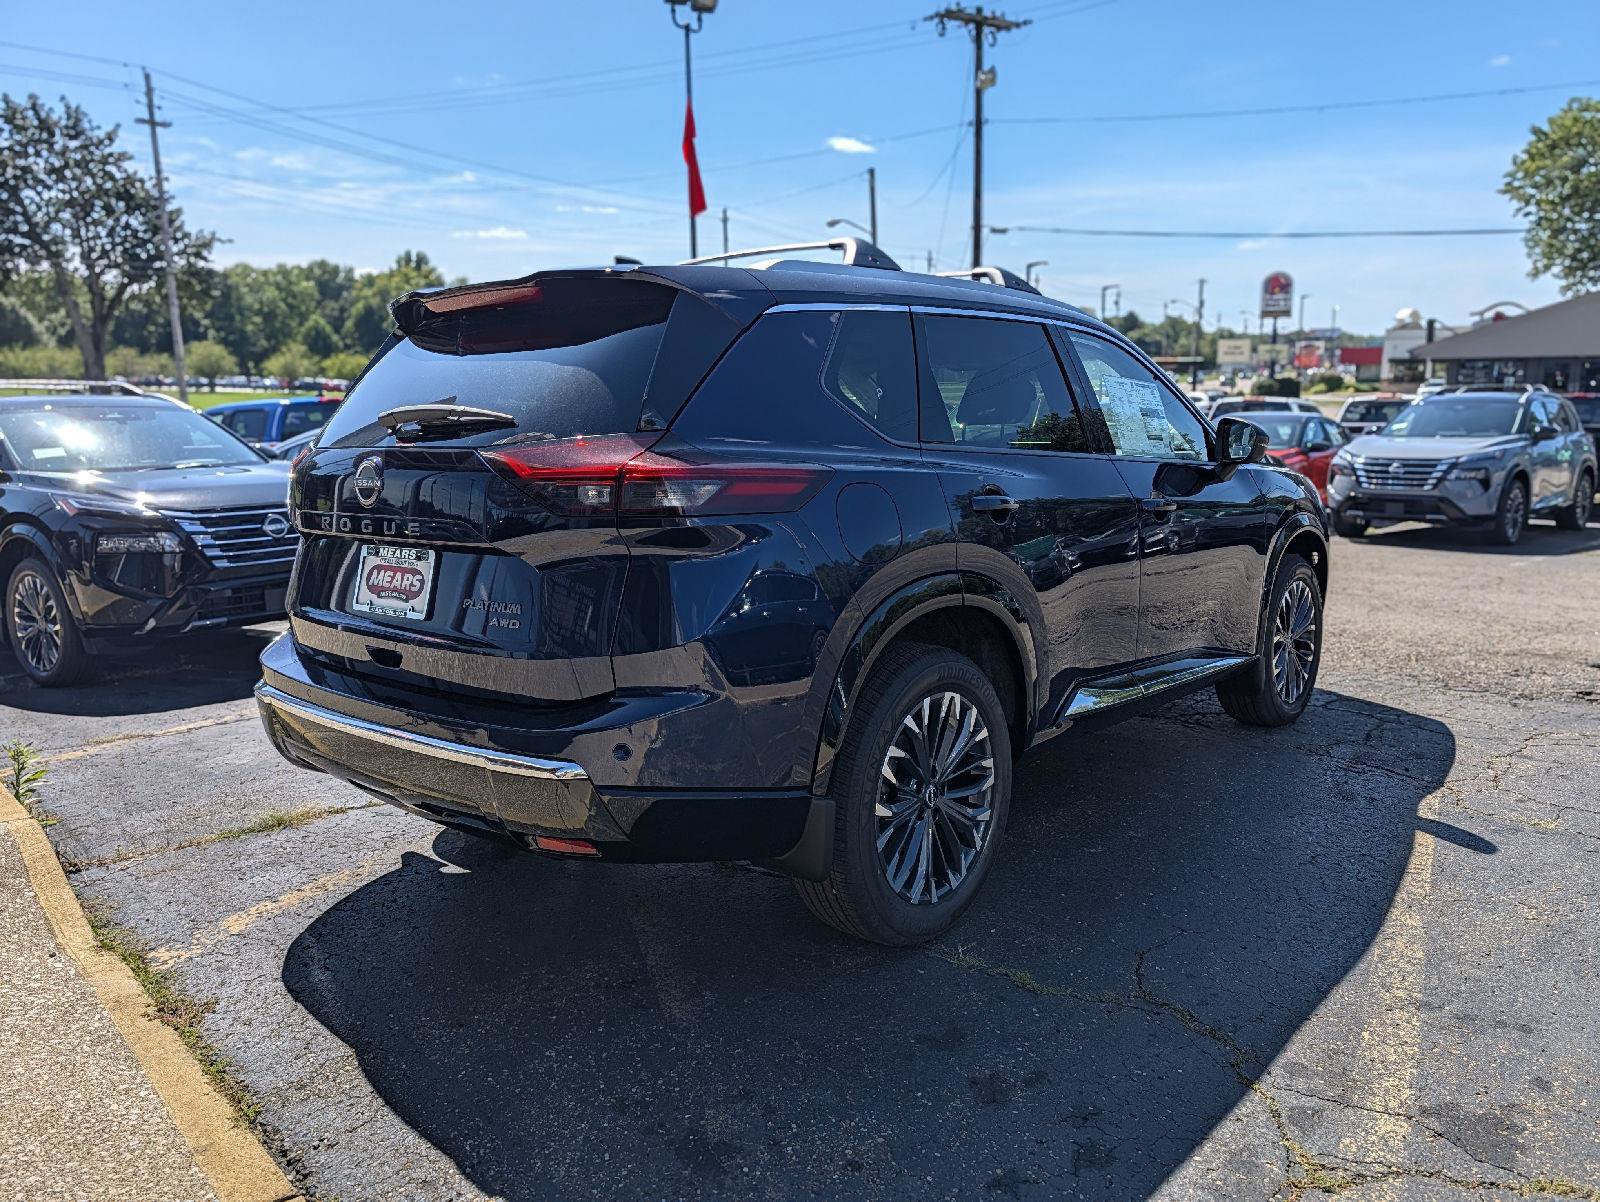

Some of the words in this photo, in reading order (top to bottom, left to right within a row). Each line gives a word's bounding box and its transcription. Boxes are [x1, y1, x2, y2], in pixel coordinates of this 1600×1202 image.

[321, 516, 420, 536] ROGUE
[379, 547, 417, 560] MEARS
[368, 569, 423, 592] MEARS
[462, 598, 522, 615] PLATINUM
[489, 617, 521, 629] AWD
[936, 664, 998, 708] BRIDGESTON
